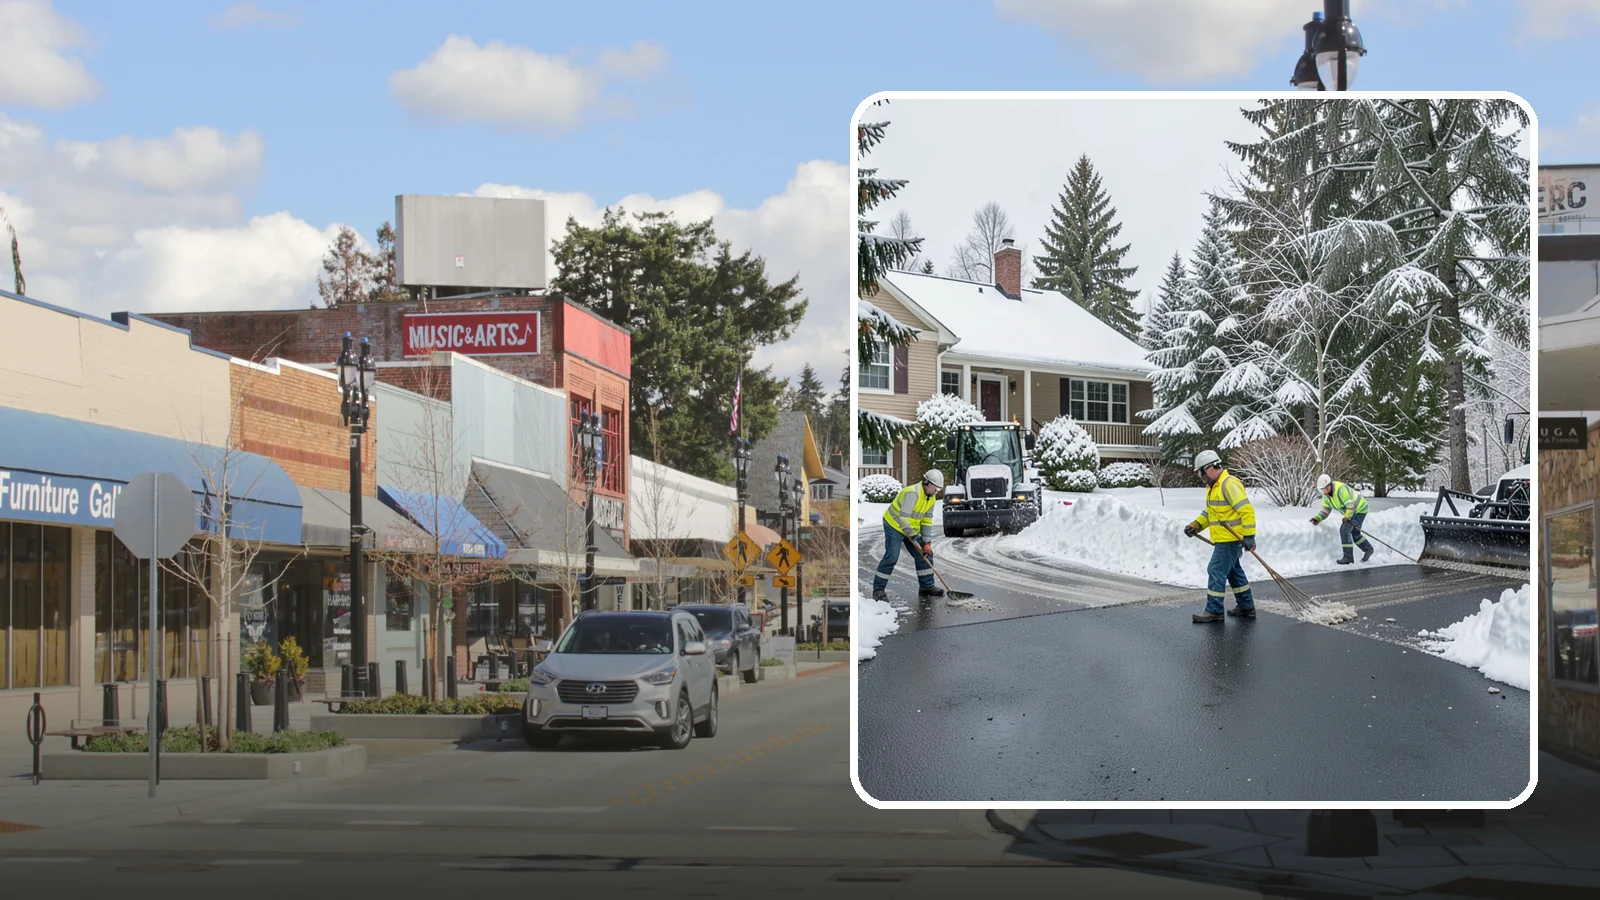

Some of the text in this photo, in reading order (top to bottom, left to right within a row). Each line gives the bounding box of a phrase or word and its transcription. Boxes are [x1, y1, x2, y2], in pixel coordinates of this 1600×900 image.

[409, 323, 519, 348] MUSIC&ARTS
[1540, 427, 1577, 437] UGA
[0, 472, 79, 515] Furniture
[453, 564, 480, 574] SUSHI
